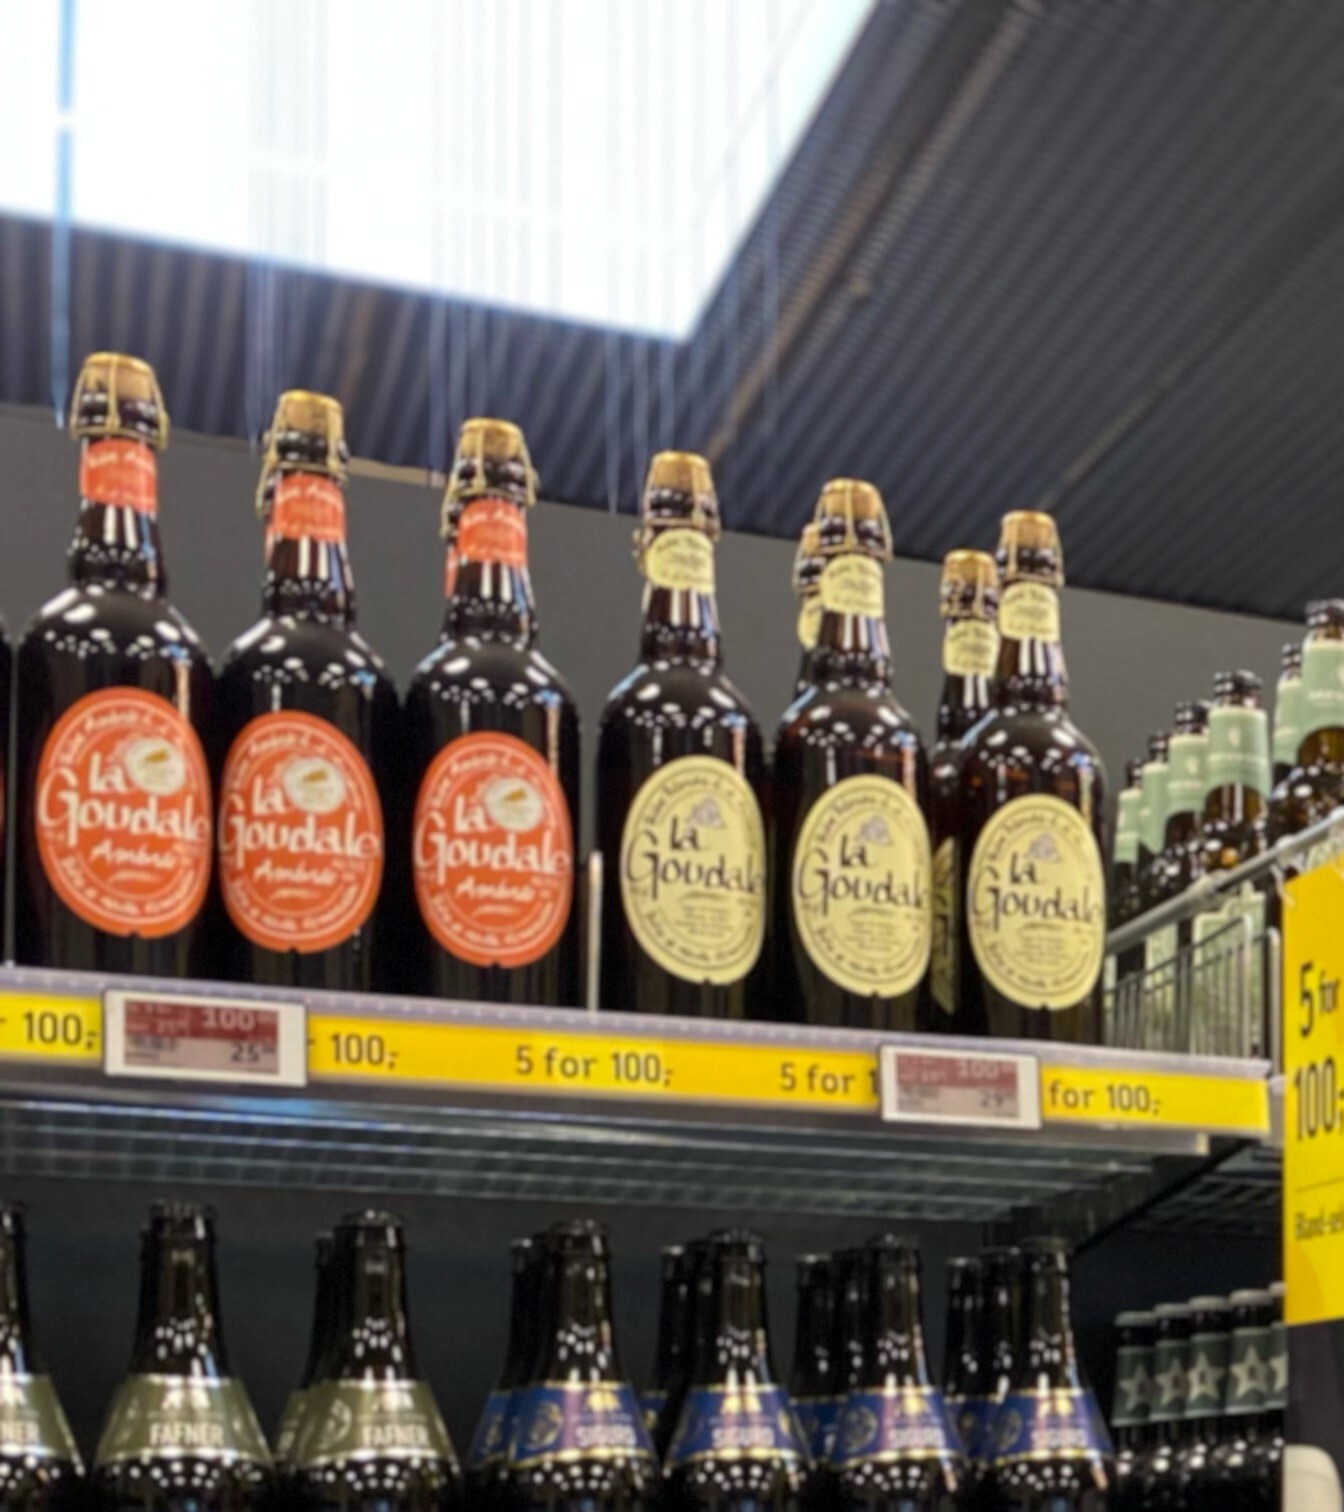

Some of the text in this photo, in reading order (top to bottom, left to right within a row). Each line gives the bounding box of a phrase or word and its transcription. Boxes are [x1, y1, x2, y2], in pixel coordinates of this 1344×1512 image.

[219, 795, 379, 869] Goudale
[1299, 960, 1314, 1039] 5
[515, 1046, 533, 1075] 5
[545, 1047, 597, 1079] for
[780, 1062, 855, 1094] 5 for
[1049, 1081, 1094, 1108] for
[0, 1422, 39, 1444] NER
